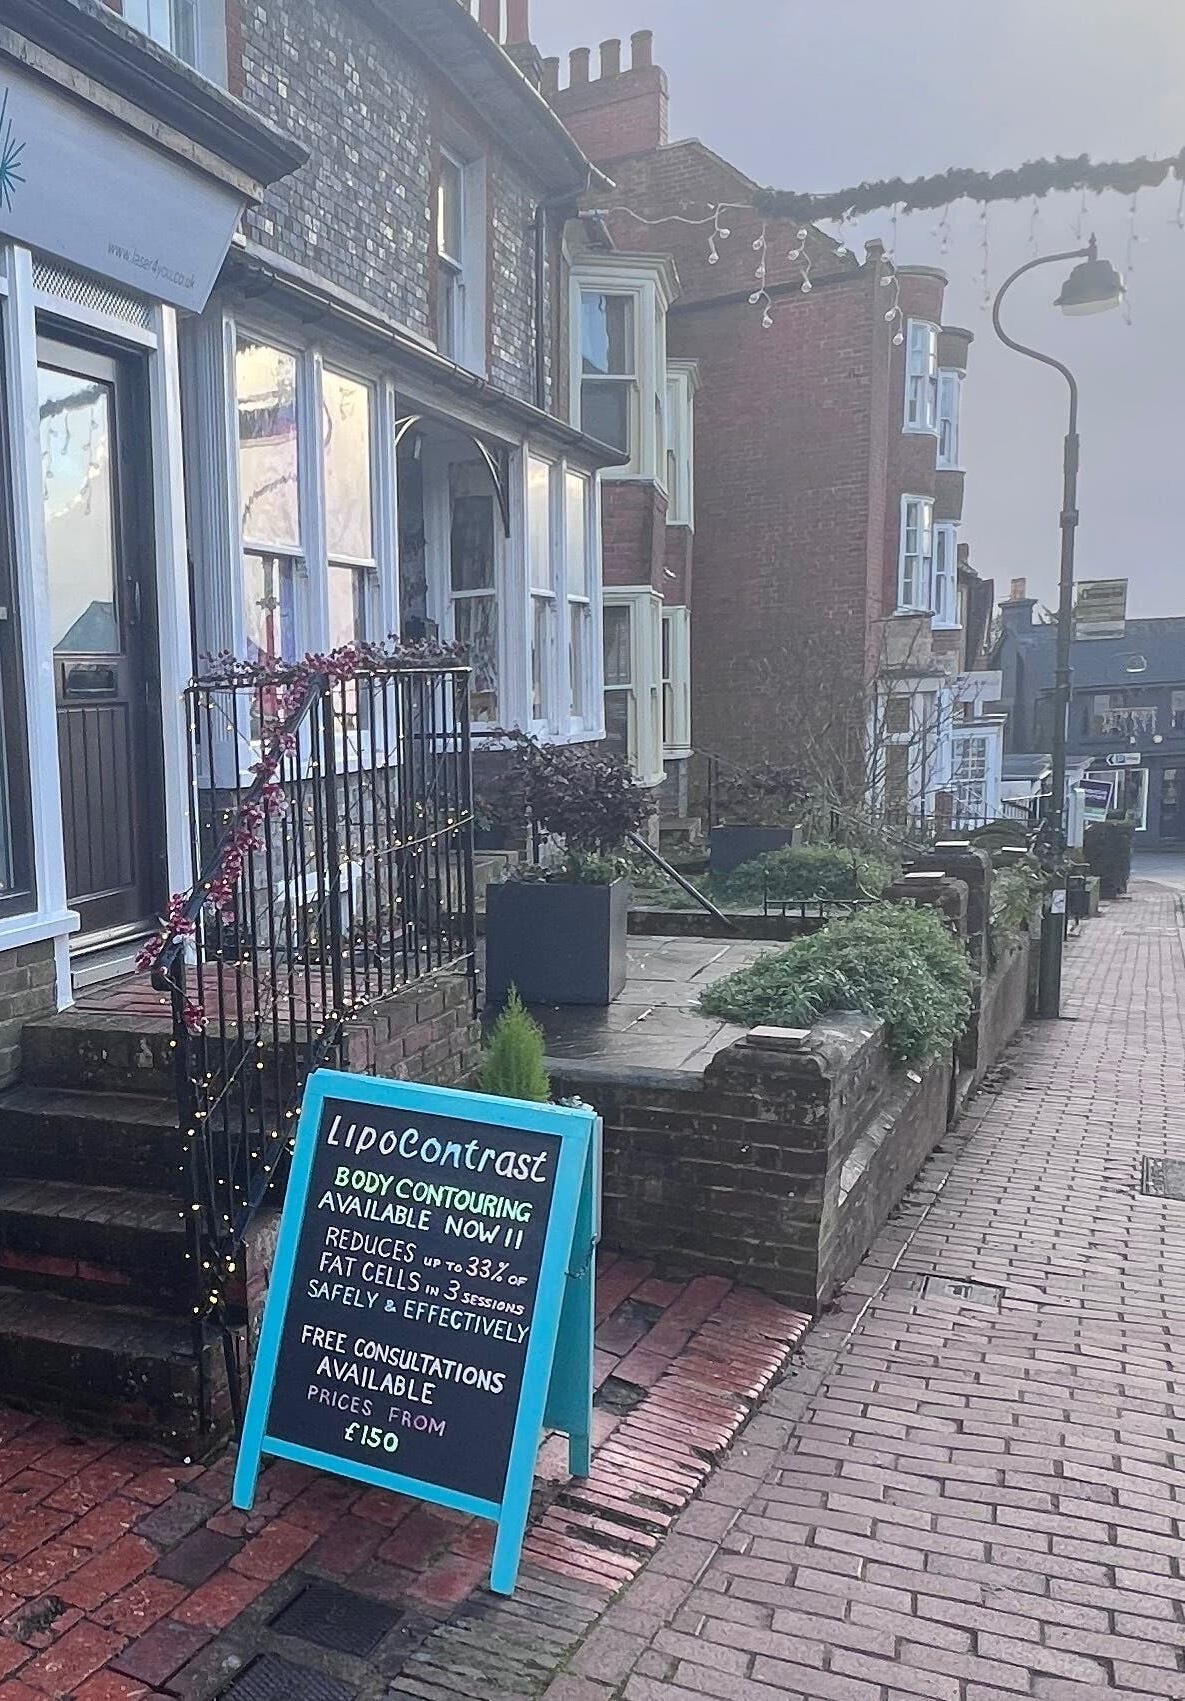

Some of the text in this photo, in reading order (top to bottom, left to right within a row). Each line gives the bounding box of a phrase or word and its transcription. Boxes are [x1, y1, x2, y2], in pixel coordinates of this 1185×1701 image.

[317, 1190, 431, 1232] AVAILABLE
[334, 1166, 533, 1222] BODY CONTOURING
[319, 1252, 525, 1316] FAT CELLS IN 3 SESSIONS
[325, 1226, 528, 1288] REDUCES UP TO 33% OF
[307, 1279, 530, 1344] SAFELY & EFFECTIVELY
[301, 1324, 507, 1394] FREE CONSULTATIONS
[316, 1355, 436, 1405] AVAILABLE
[307, 1384, 447, 1437] PRICES FROM
[344, 1420, 399, 1453] £150
